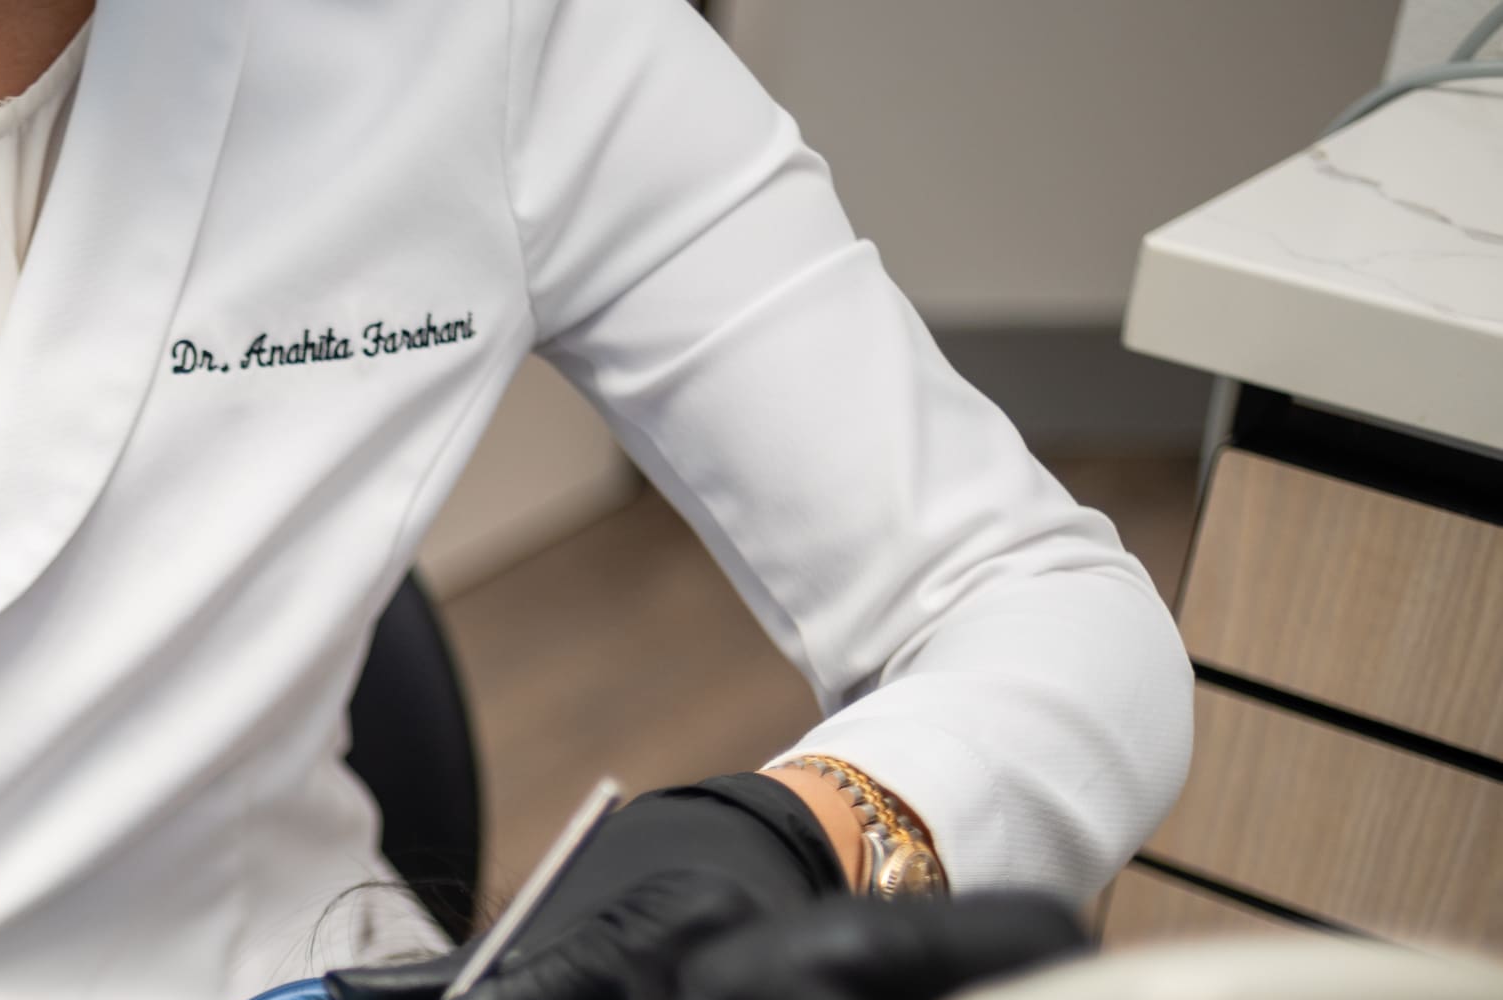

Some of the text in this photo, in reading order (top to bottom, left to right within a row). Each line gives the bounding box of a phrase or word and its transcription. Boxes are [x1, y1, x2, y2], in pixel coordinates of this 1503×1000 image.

[172, 311, 476, 374] Dr. Anahita Farahani
